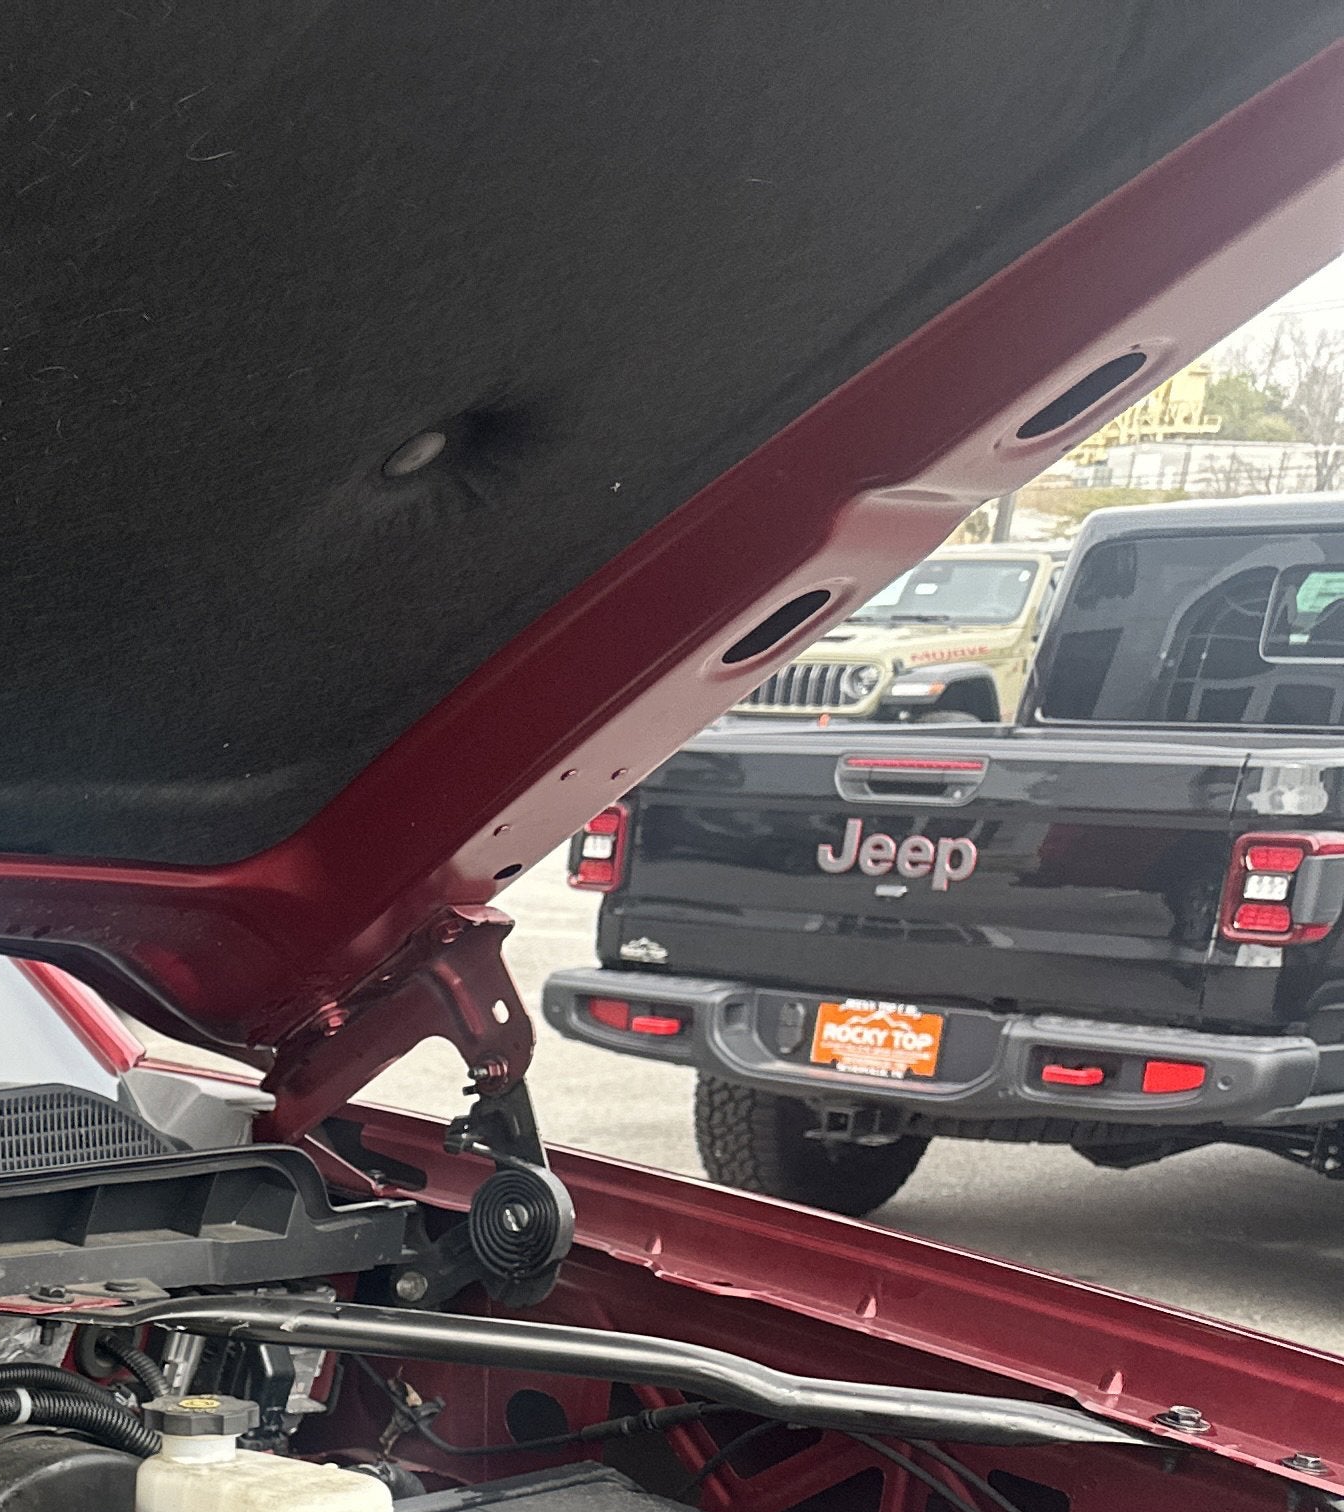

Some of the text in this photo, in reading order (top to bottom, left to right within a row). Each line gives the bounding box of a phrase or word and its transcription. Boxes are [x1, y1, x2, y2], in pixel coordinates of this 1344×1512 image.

[817, 818, 977, 891] Jeep
[822, 1023, 933, 1051] ROCKY TOP
